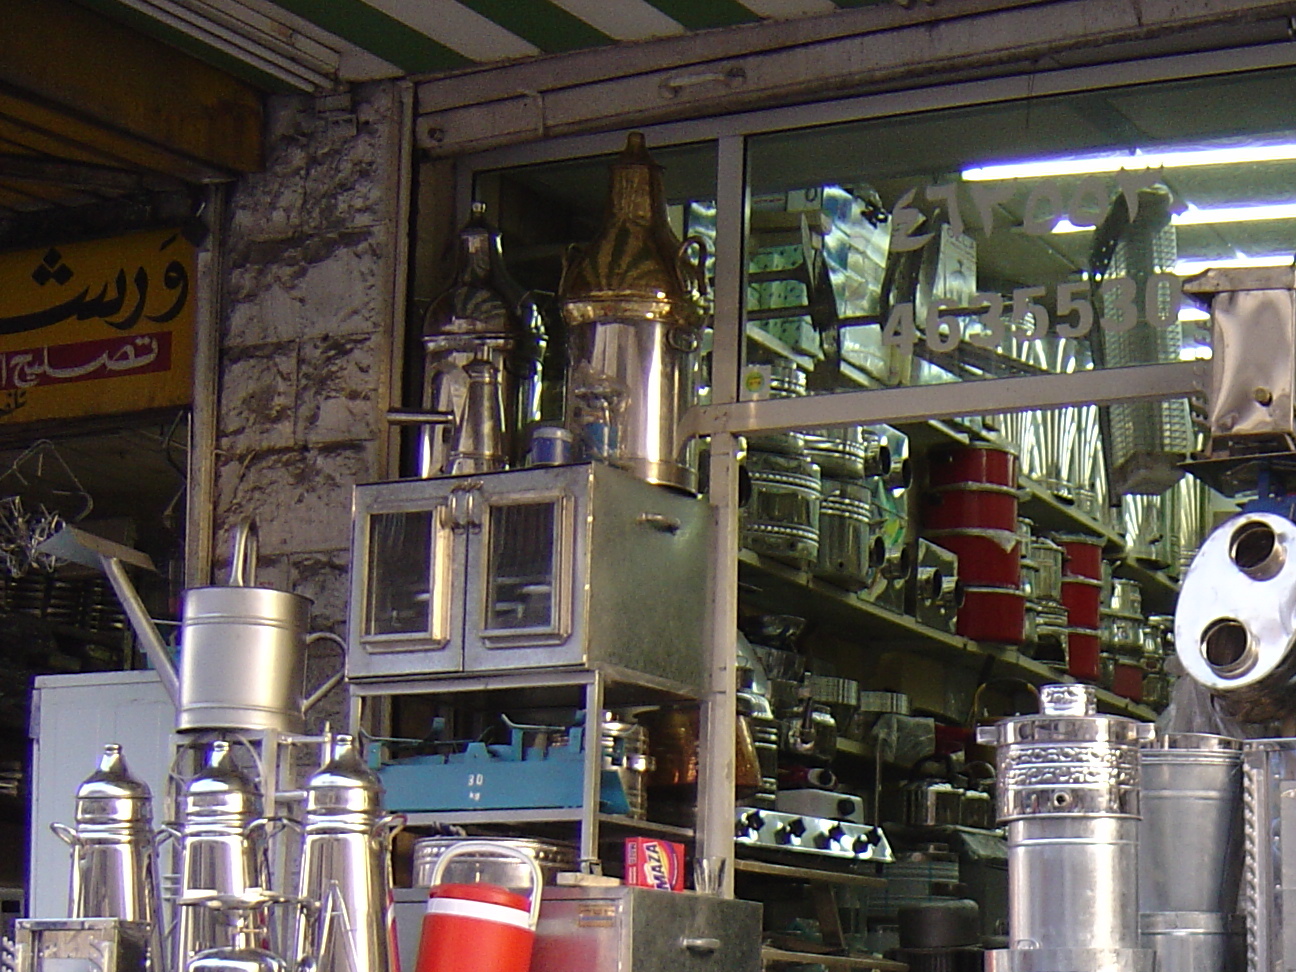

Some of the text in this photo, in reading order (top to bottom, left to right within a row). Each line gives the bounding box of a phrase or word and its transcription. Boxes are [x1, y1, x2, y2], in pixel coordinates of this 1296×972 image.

[882, 273, 1181, 357] 4635530
[10, 336, 158, 388] تصليح
[468, 773, 483, 786] 30
[645, 843, 670, 890] MAZA
